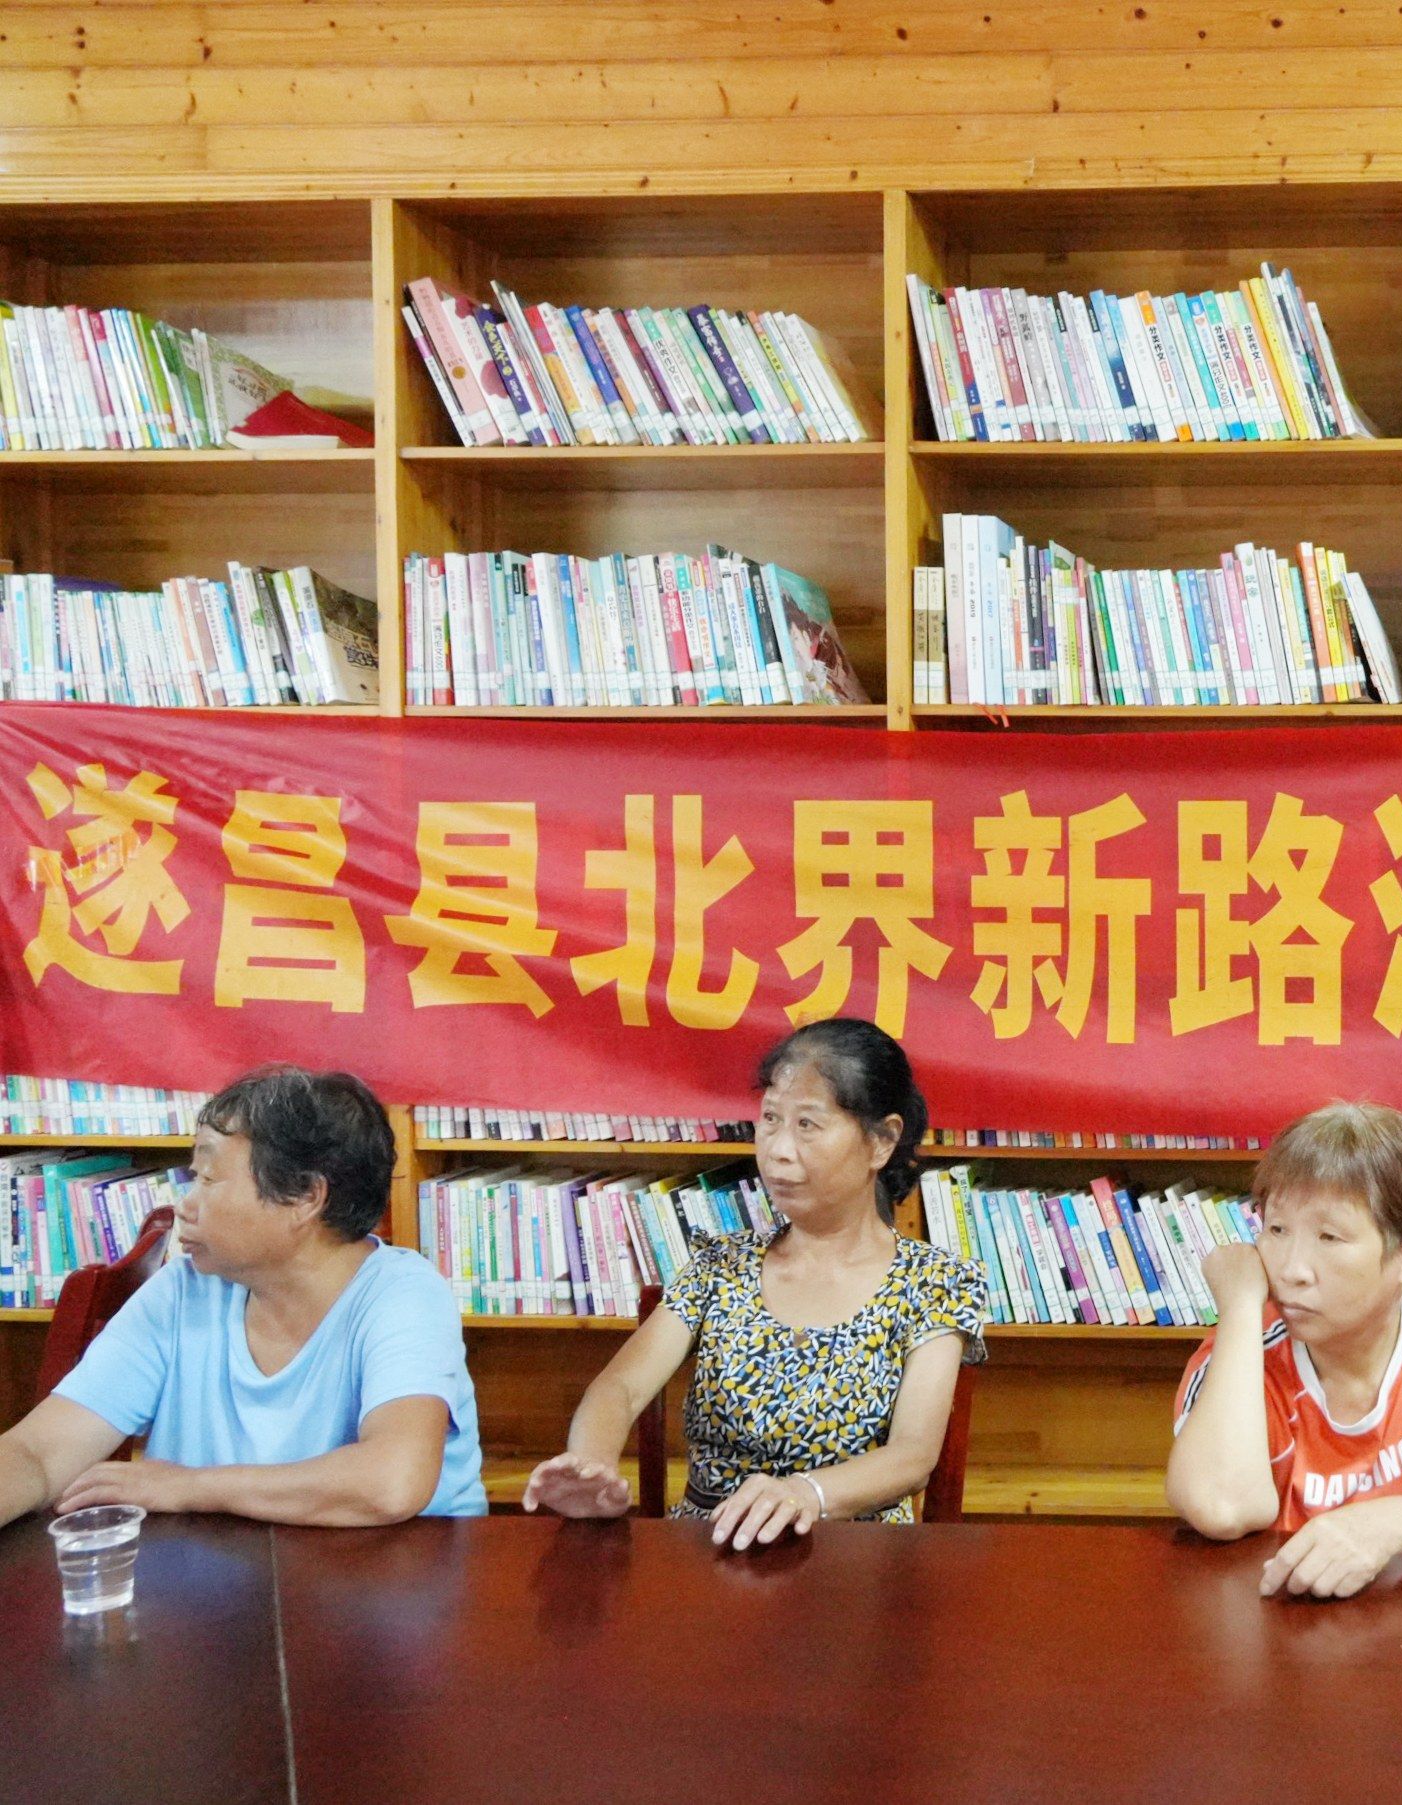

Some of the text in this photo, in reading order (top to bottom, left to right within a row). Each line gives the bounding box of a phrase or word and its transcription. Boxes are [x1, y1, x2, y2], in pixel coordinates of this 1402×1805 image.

[1147, 325, 1165, 361] 分类作文
[1214, 325, 1232, 361] 分类作文
[1243, 324, 1261, 361] 分类作文
